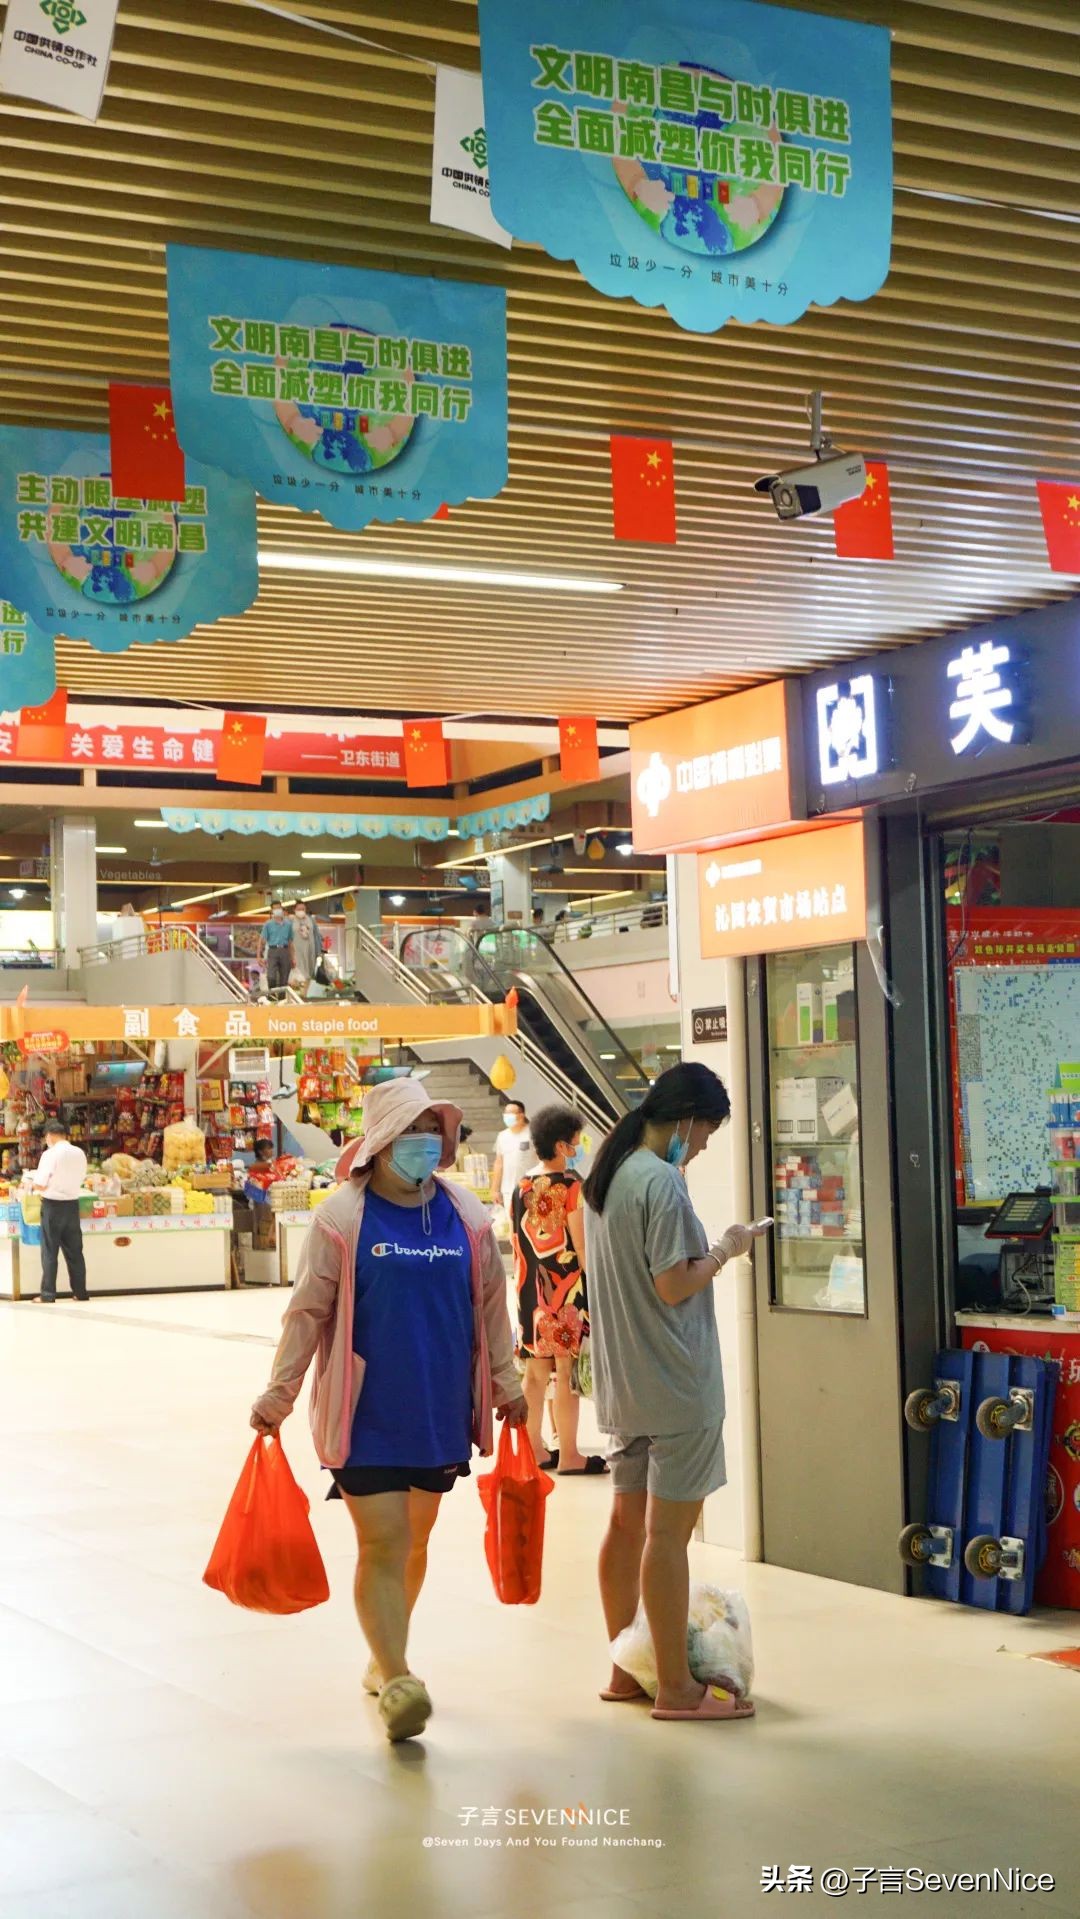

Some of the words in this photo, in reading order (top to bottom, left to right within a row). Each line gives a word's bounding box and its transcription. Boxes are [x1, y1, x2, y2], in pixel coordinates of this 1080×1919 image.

[14, 30, 97, 67] 中国供销合作社
[24, 46, 53, 59] CHINA
[55, 56, 85, 69] CO-OP
[531, 45, 850, 143] 文明南昌与时俱进
[533, 101, 850, 197] 全面减塑你我同行
[452, 181, 477, 193] CHINA
[478, 188, 490, 198] CO
[610, 253, 693, 280] 垃圾少一分
[711, 271, 789, 297] 城市美十分
[210, 315, 471, 379] 文明南昌与时俱进
[211, 359, 471, 422] 全面减塑你我同行
[273, 474, 340, 493] 垃圾少一分
[354, 484, 421, 501] 城市美十分
[18, 510, 207, 552] 共建文明南昌
[947, 640, 1014, 755] 芙
[71, 733, 214, 762] 关爱生命健
[100, 869, 162, 881] Vegetables
[123, 1008, 251, 1037] 副食品
[268, 1019, 297, 1032] Non
[302, 1018, 344, 1034] staple
[347, 1018, 378, 1032] food
